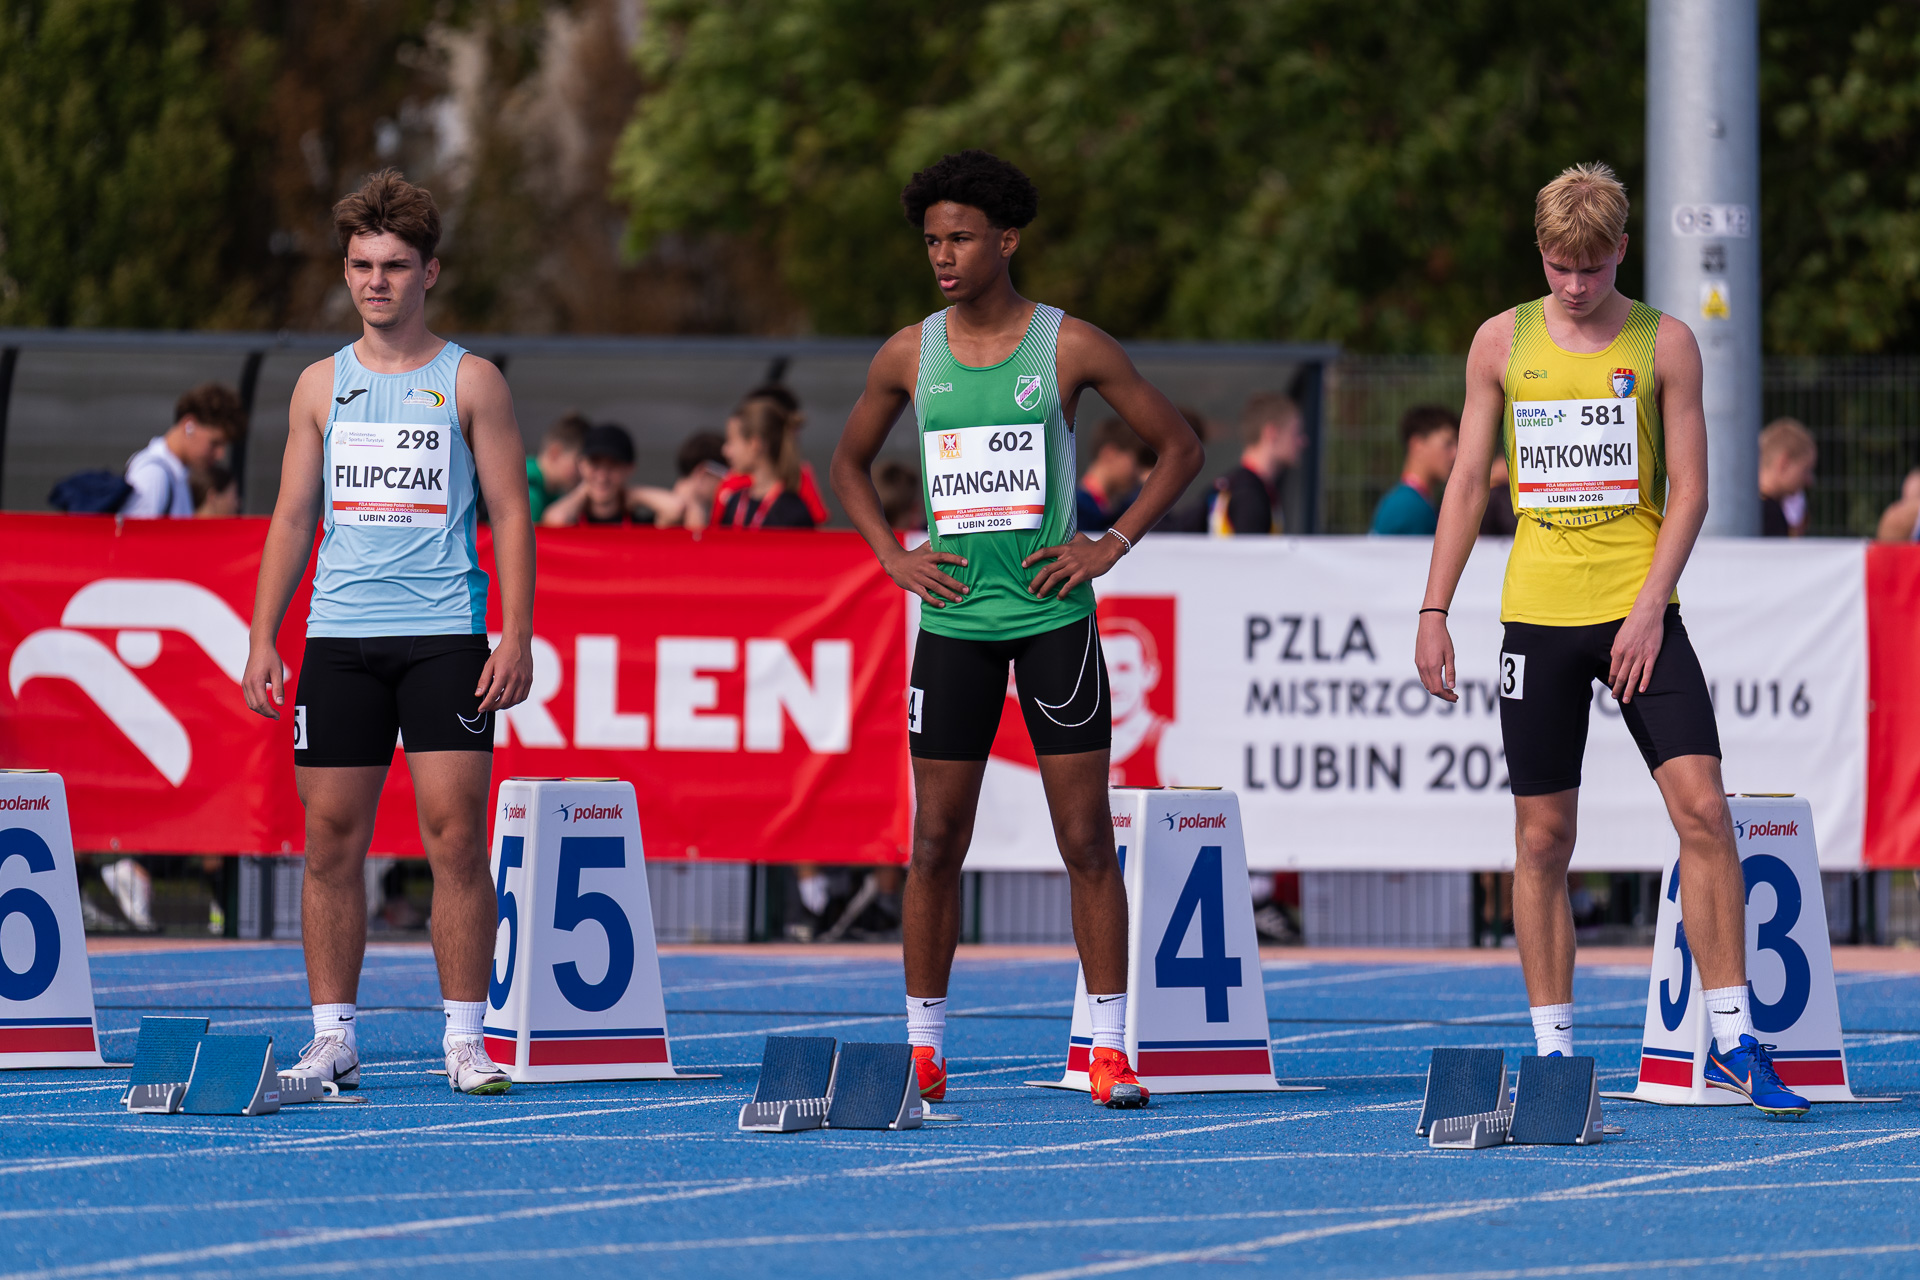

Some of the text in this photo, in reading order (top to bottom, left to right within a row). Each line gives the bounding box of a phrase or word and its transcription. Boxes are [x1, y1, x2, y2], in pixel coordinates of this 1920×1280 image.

[1524, 370, 1548, 379] esa
[930, 382, 953, 394] esa
[1516, 408, 1547, 418] GRUPA
[1517, 418, 1554, 427] LUXMED
[1580, 405, 1624, 426] 581
[396, 430, 439, 450] 298
[989, 431, 1033, 452] 602
[941, 450, 960, 458] PZLA
[1520, 443, 1631, 473] PIĄTKOWSKI
[336, 465, 443, 490] FILIPCZAK
[932, 469, 1040, 498] ATANGANA
[388, 515, 412, 523] 2026
[958, 520, 985, 529] LUBIN
[1245, 615, 1376, 662] PZLA
[1504, 657, 1516, 694] 3
[487, 632, 852, 754] RLEN
[1246, 679, 1501, 716] MISTRZOTW
[1735, 680, 1812, 717] U16
[909, 691, 916, 728] 4
[1245, 744, 1510, 790] LUBIN 20
[0, 795, 50, 811] polanik
[508, 804, 526, 821] polanik
[573, 804, 623, 823] polanik
[1178, 813, 1227, 832] polanik
[1749, 820, 1798, 840] polanik
[0, 827, 61, 1002] 6
[488, 835, 524, 1010] 5
[552, 836, 635, 1012] 5
[1155, 846, 1242, 1023] 4
[1660, 857, 1692, 1032] 3
[1741, 854, 1811, 1033] 3
